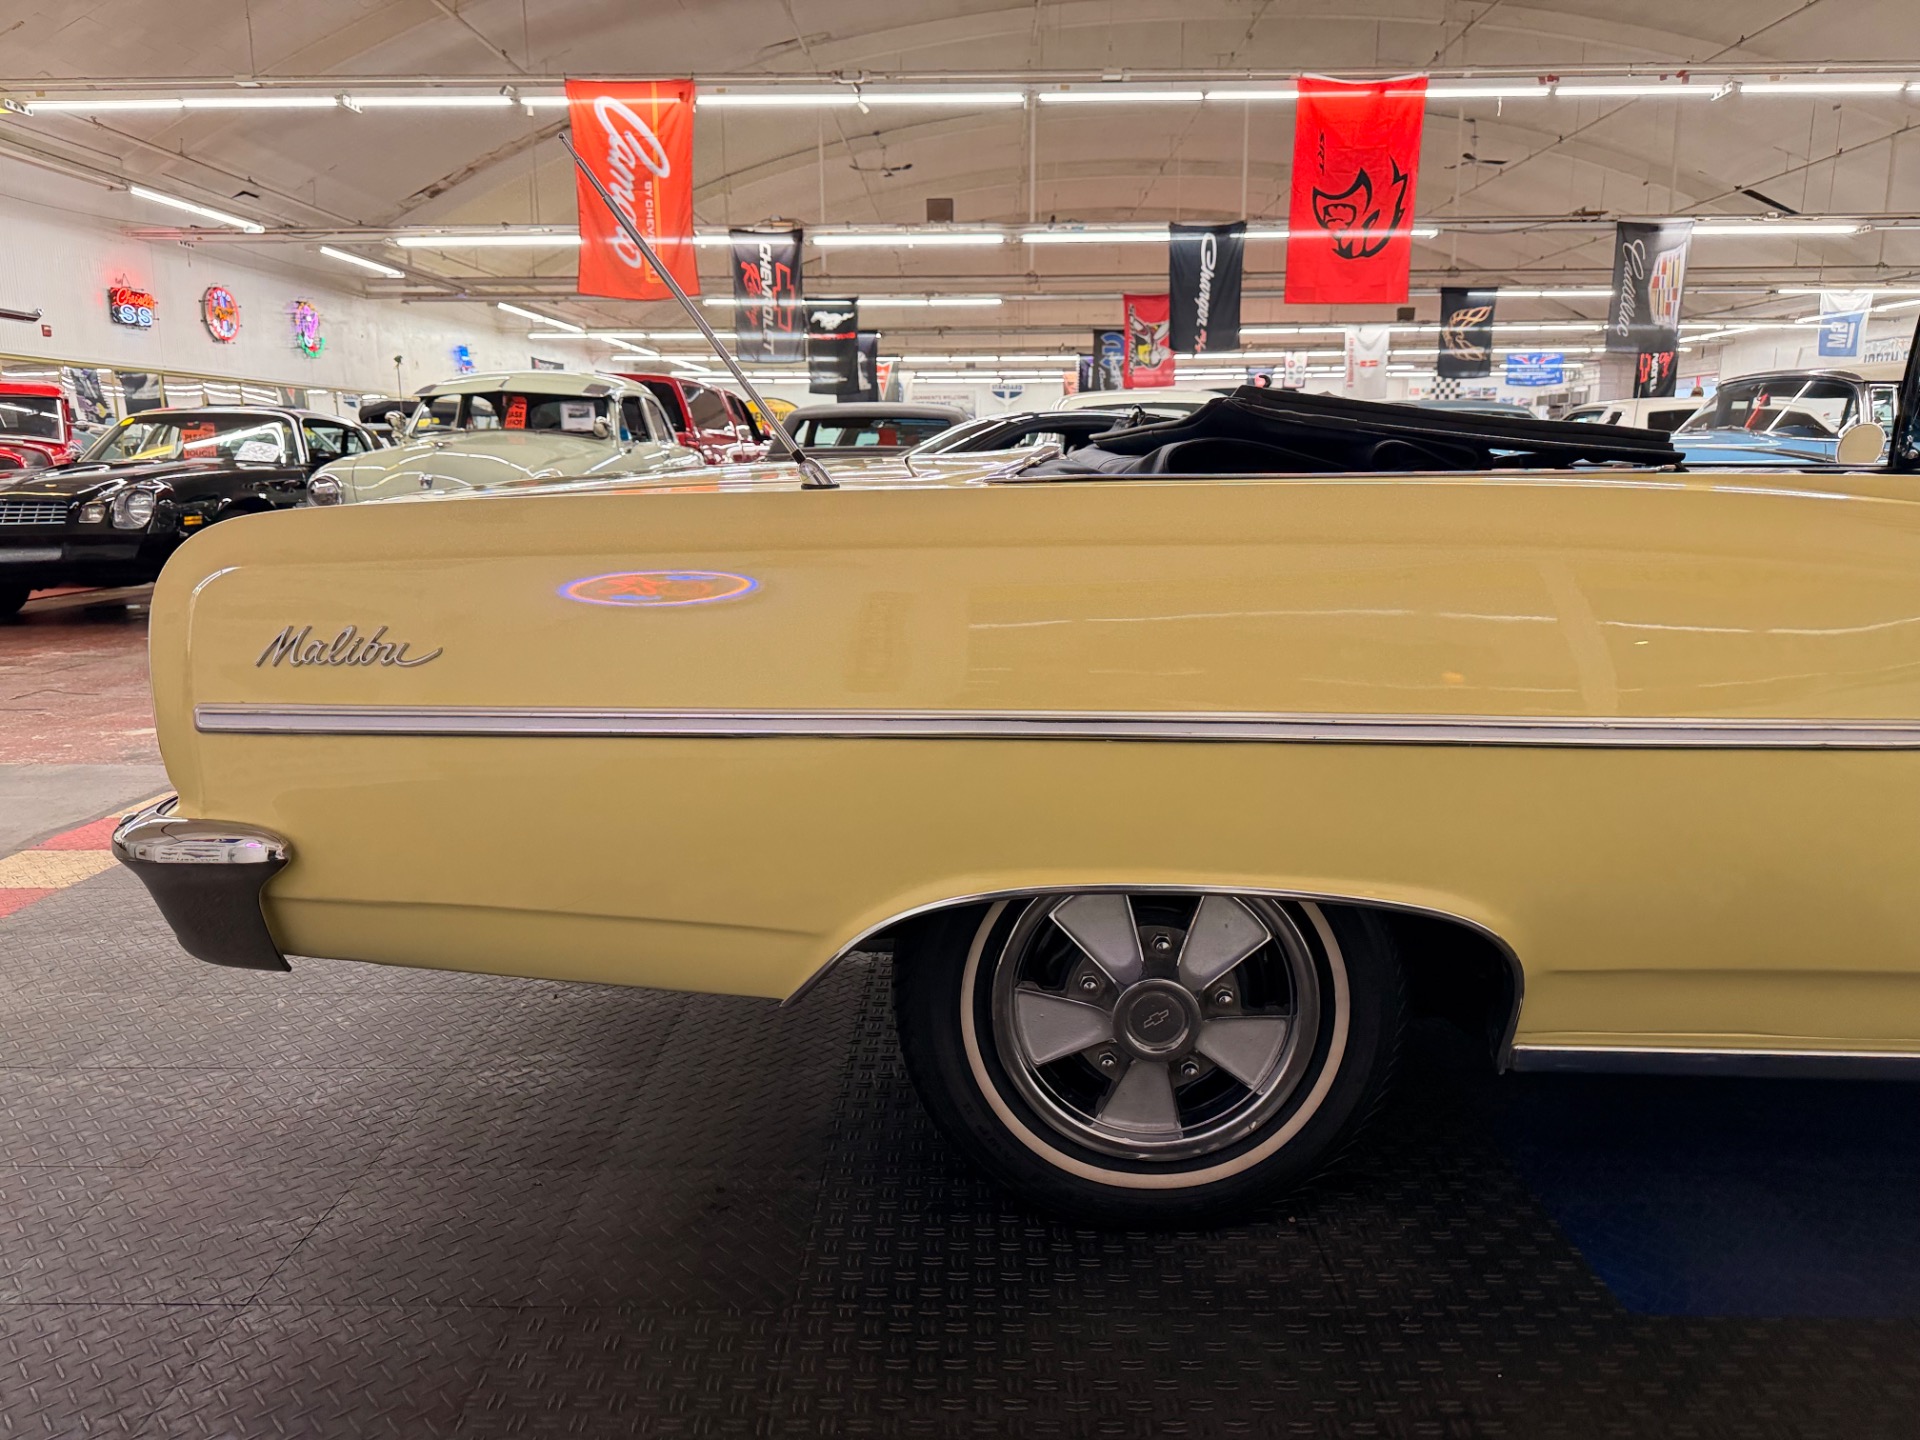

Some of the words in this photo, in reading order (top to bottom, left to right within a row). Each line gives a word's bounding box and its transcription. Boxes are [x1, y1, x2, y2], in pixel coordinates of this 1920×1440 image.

[644, 181, 653, 198] BY
[758, 242, 774, 355] CHEVROLET
[1194, 232, 1217, 326] Charger
[1616, 239, 1646, 337] Cadillac
[119, 304, 153, 326] SS
[255, 625, 443, 667] Malibu
